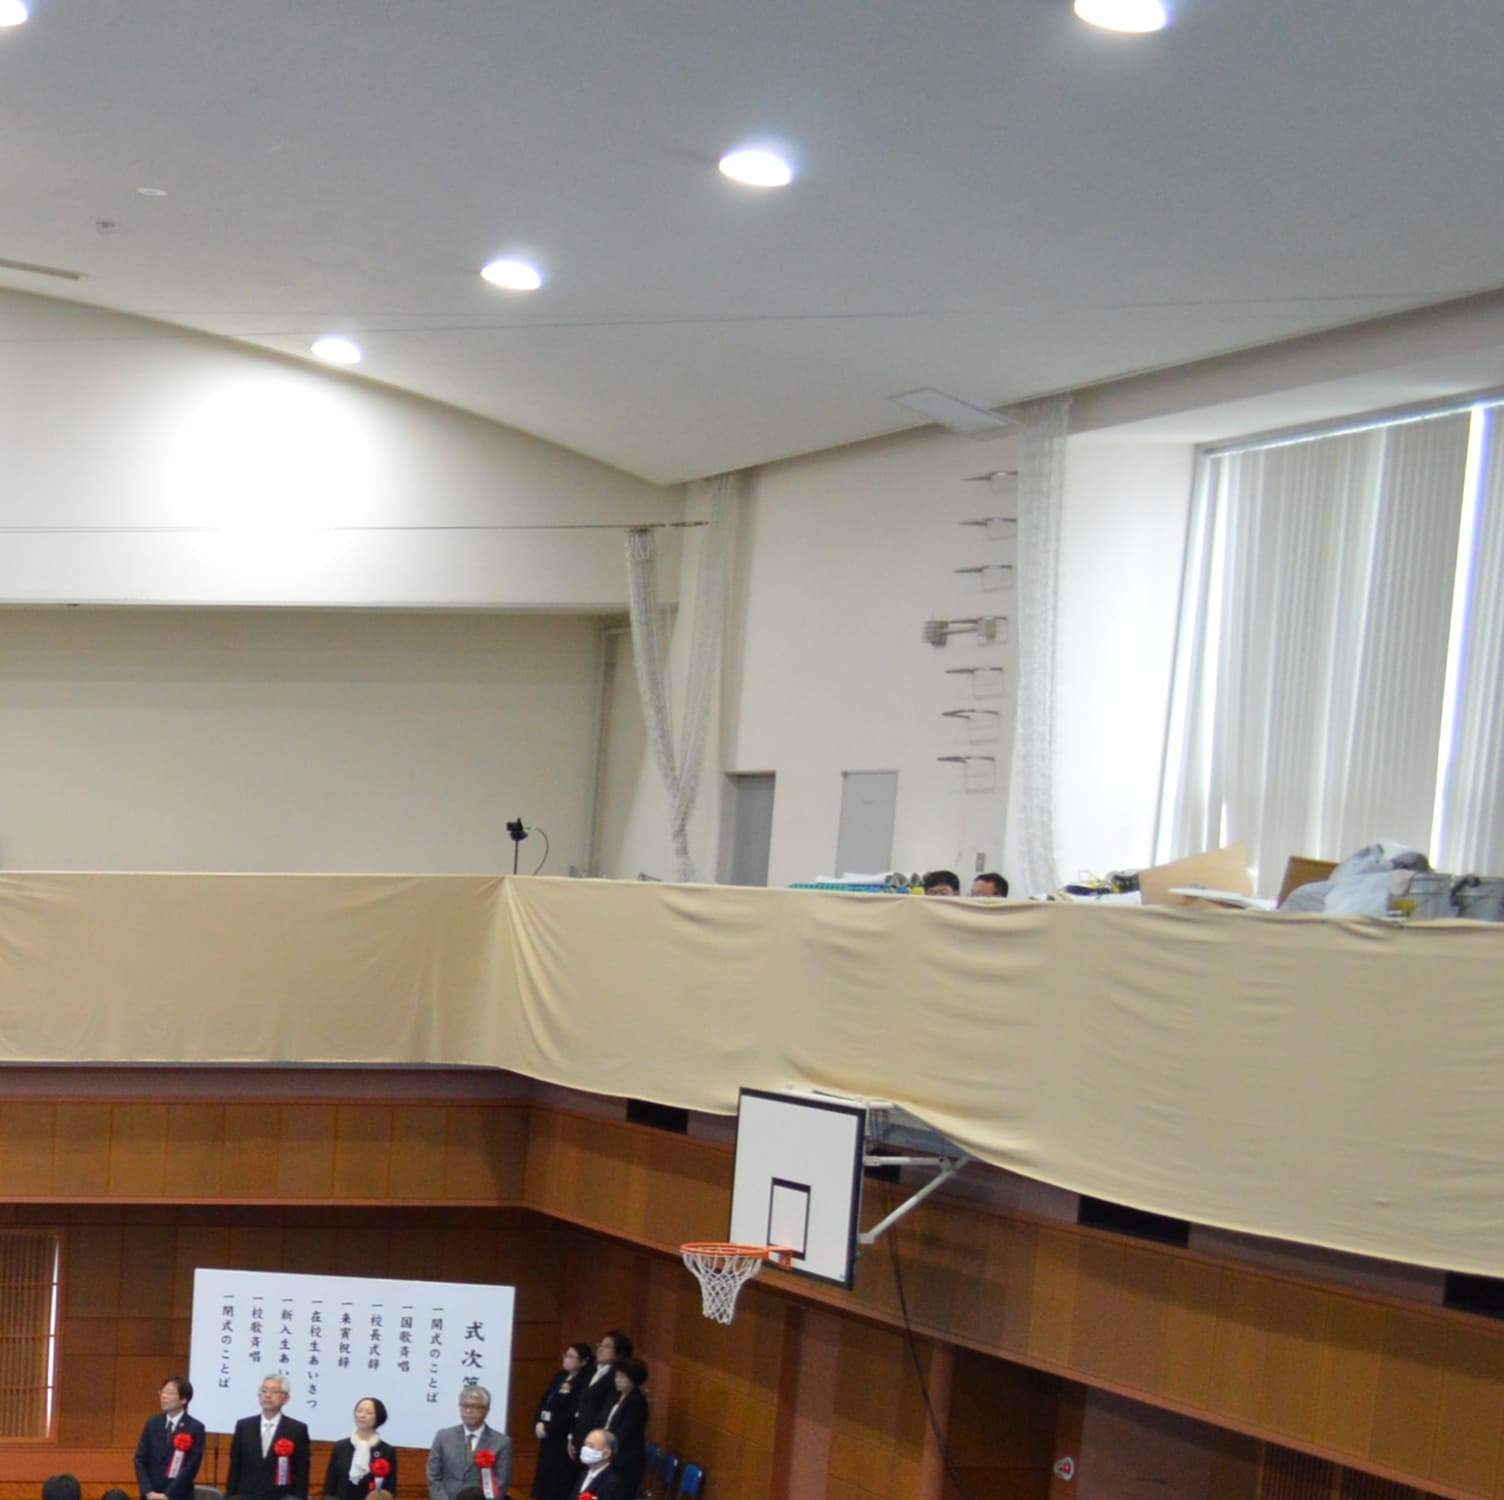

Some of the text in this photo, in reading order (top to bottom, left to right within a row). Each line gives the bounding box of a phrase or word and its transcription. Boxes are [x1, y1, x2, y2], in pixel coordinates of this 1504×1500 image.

[278, 1298, 294, 1375] 一新入生あい
